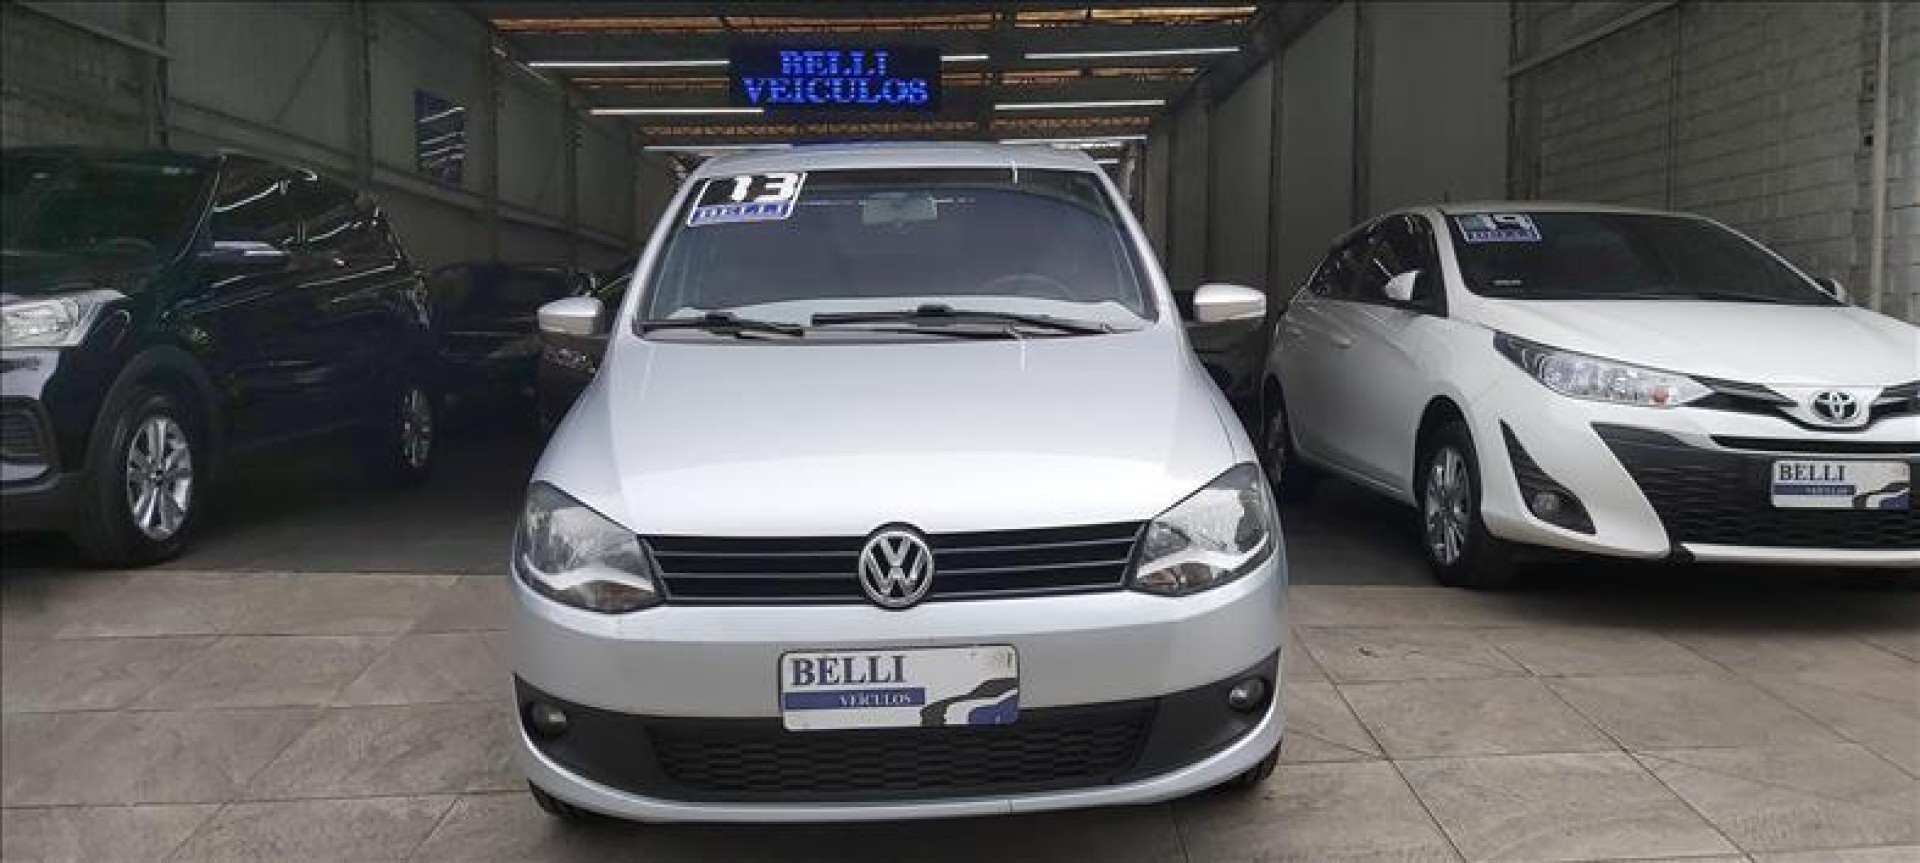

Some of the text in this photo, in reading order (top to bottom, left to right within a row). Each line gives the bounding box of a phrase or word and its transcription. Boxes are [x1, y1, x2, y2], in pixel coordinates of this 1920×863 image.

[781, 51, 888, 76] BELLI
[742, 78, 928, 103] VEICULOS
[1779, 464, 1847, 481] BELLI
[790, 655, 906, 686] BELLI
